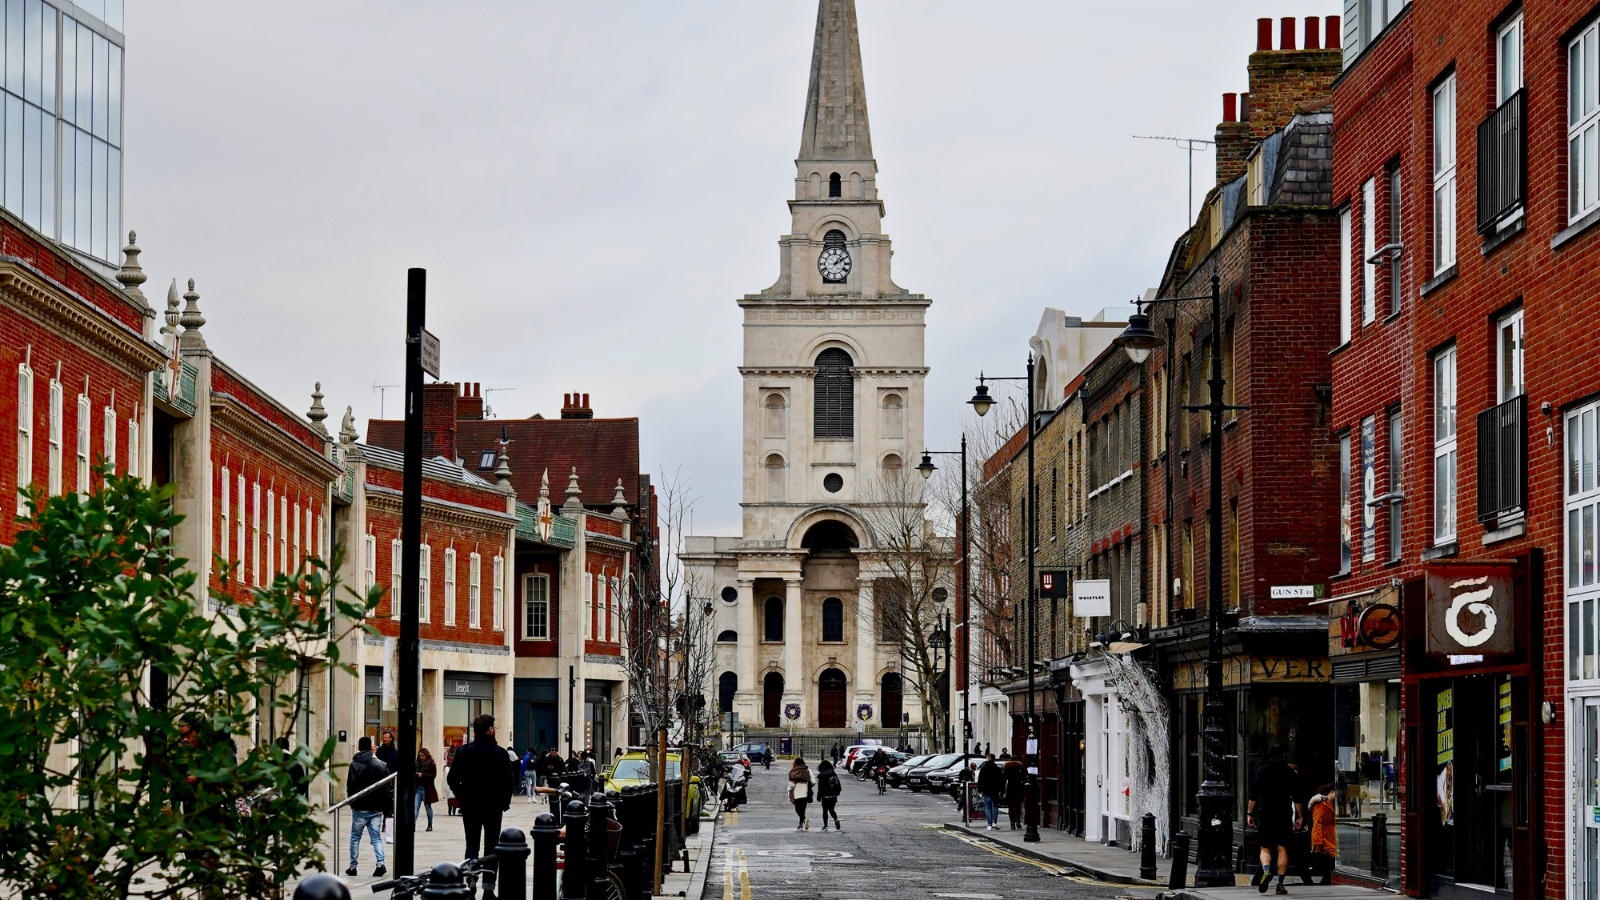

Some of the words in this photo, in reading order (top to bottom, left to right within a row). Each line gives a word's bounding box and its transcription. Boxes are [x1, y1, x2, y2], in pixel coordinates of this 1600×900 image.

[1272, 588, 1292, 596] GUN
[455, 681, 470, 695] benefit
[1437, 710, 1447, 732] ARE
